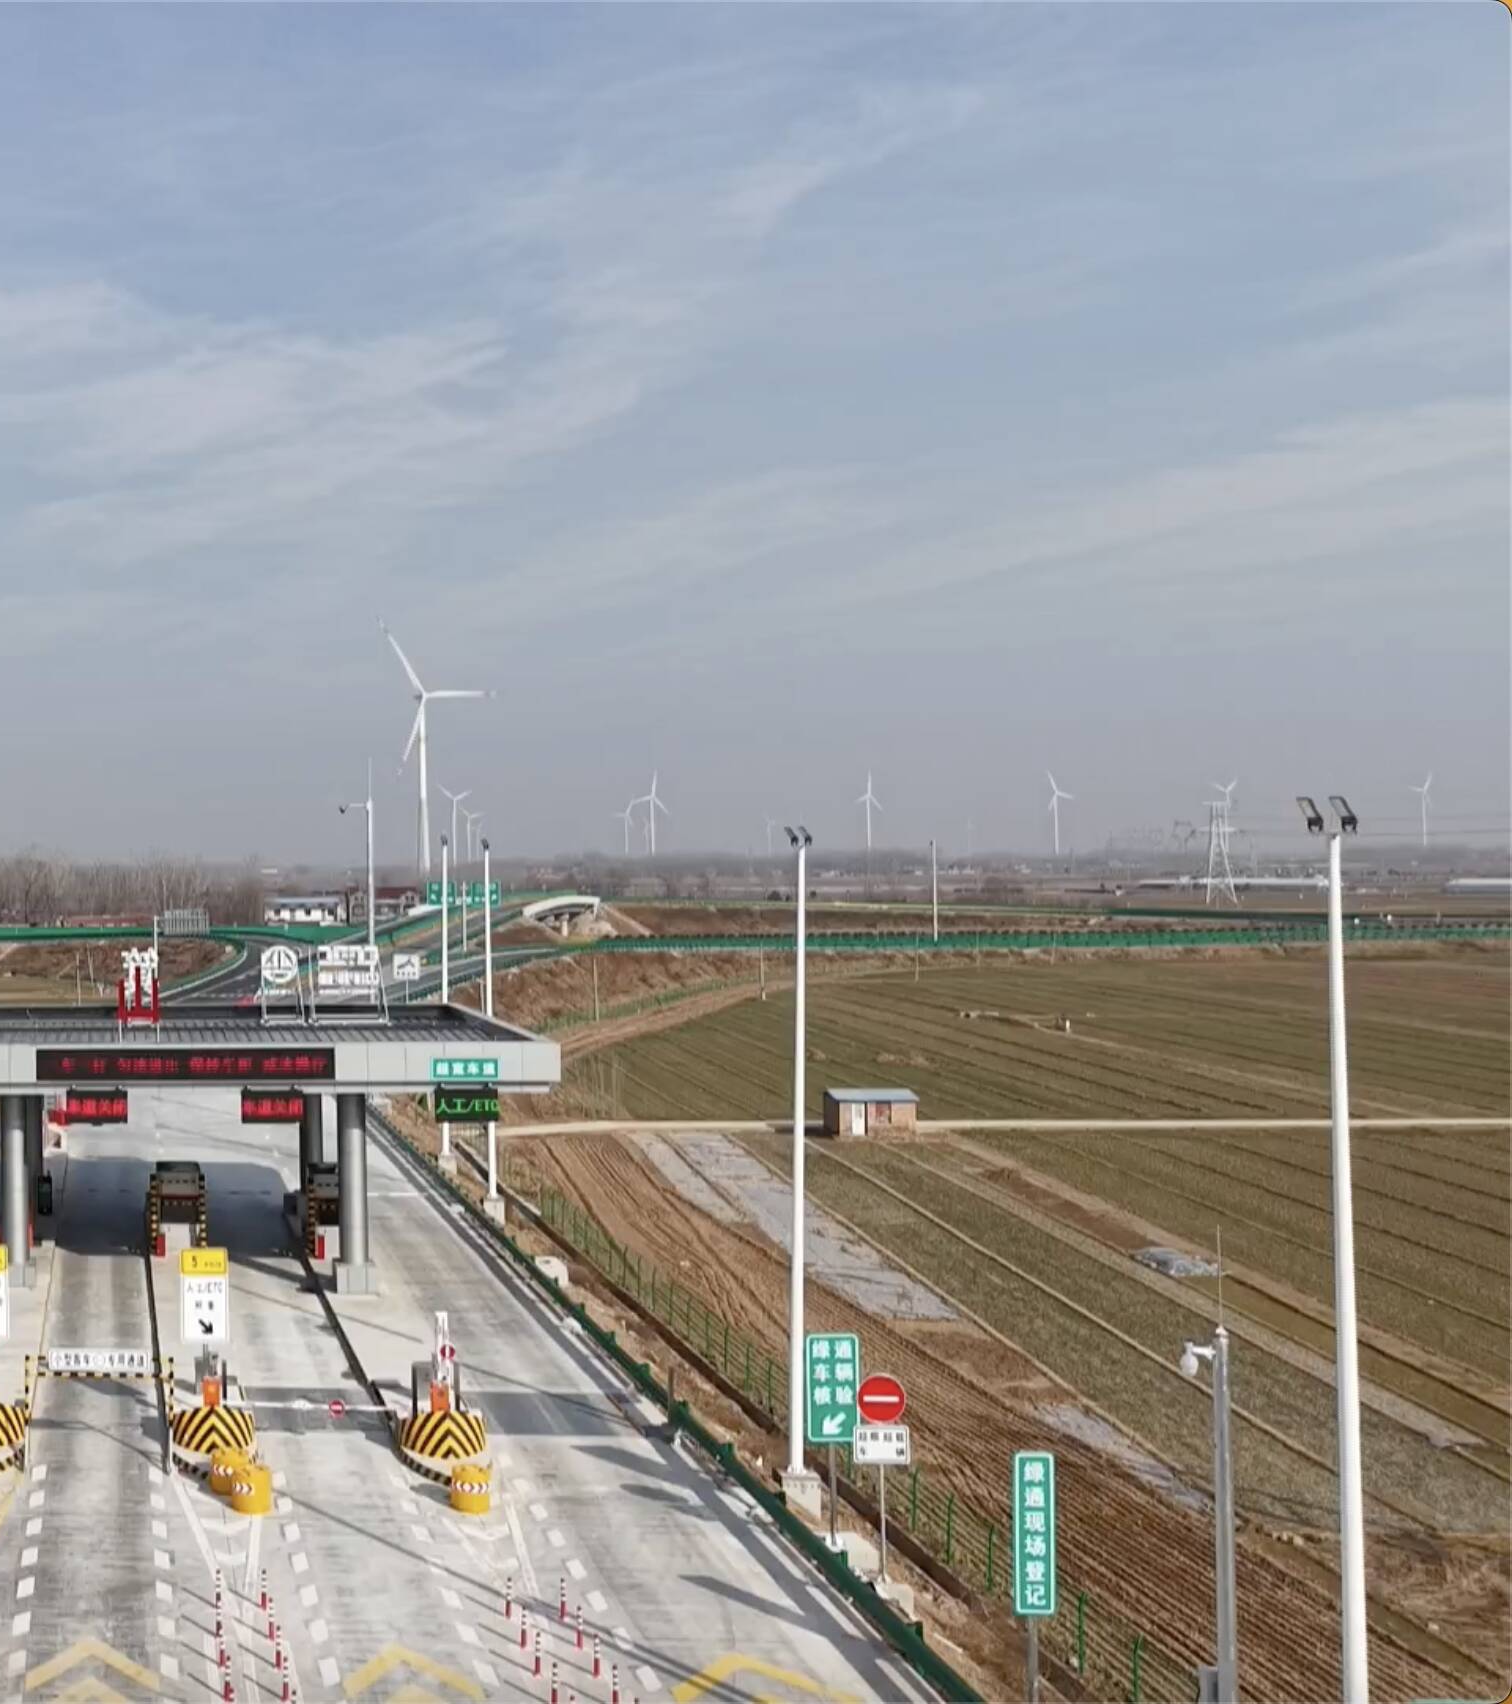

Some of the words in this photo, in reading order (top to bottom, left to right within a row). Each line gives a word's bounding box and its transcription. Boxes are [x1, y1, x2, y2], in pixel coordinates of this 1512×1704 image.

[436, 1097, 499, 1114] 人工/ETC
[812, 1362, 854, 1382] 车辆
[1022, 1461, 1047, 1607] 绿通现场登记
